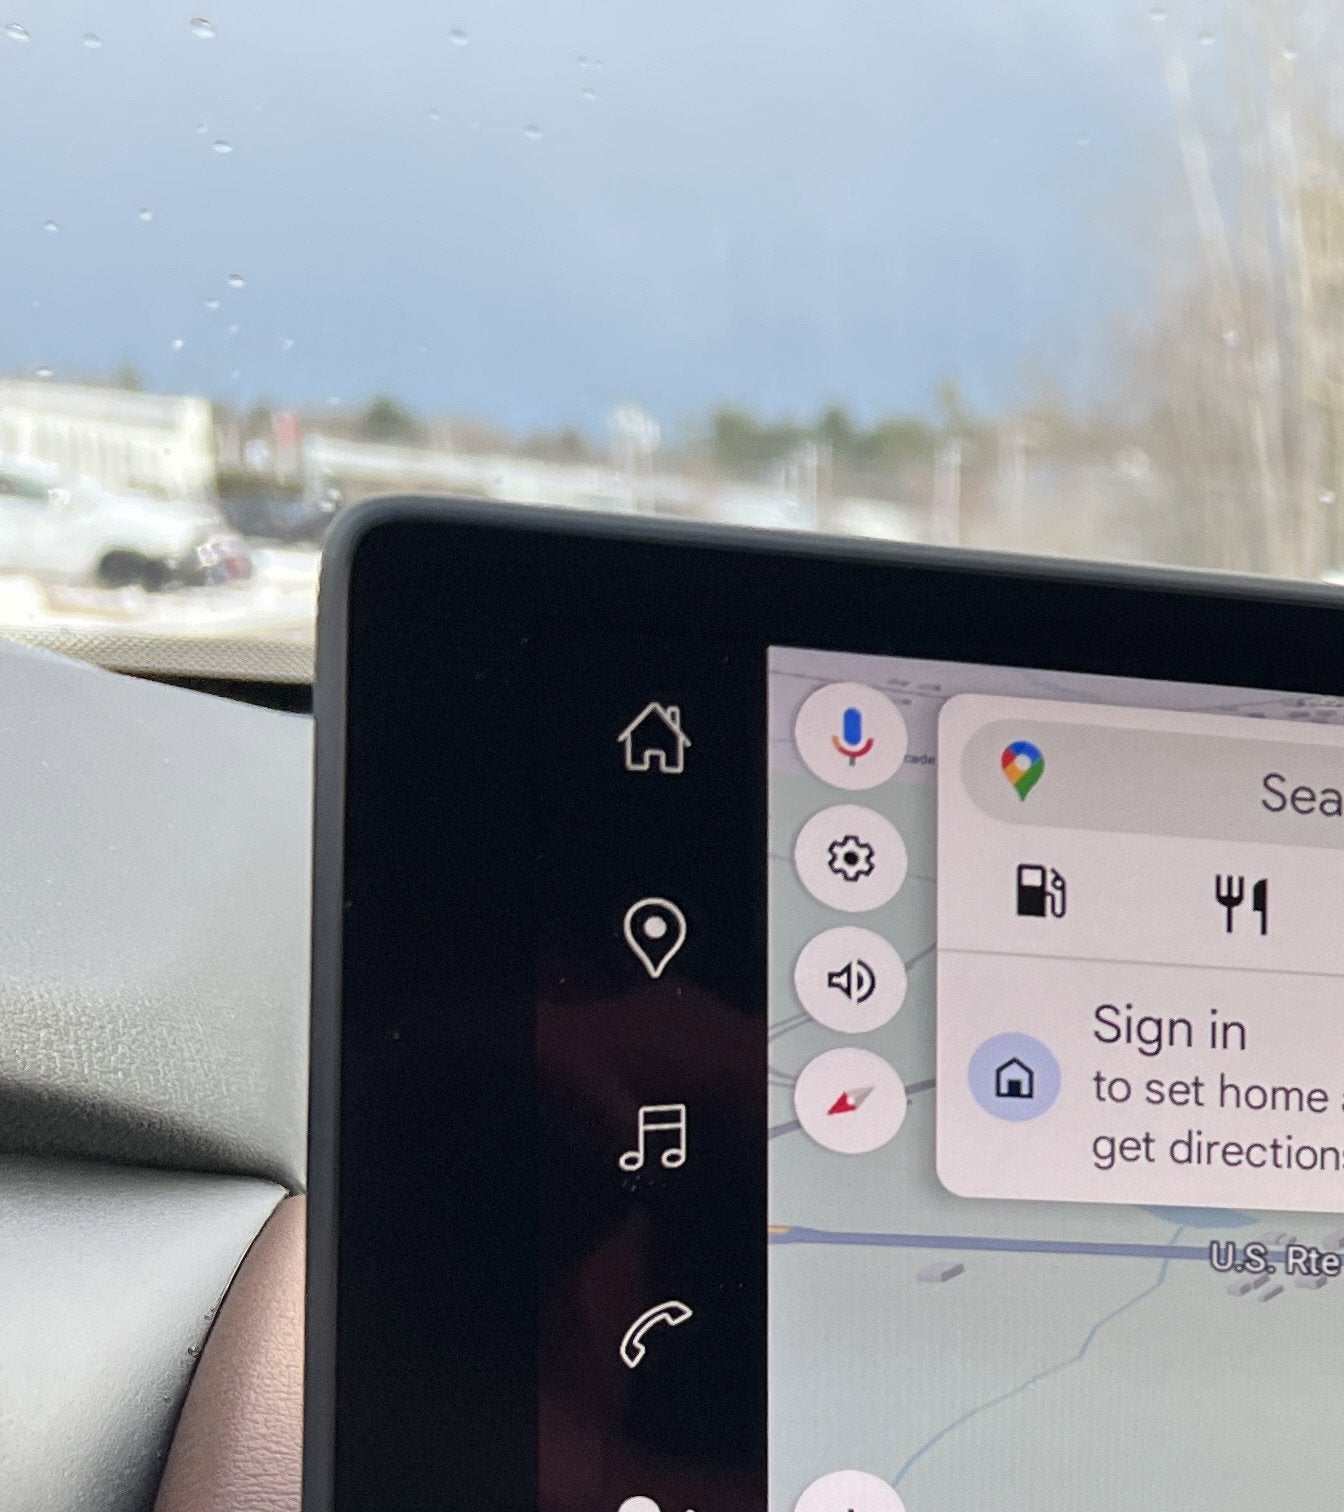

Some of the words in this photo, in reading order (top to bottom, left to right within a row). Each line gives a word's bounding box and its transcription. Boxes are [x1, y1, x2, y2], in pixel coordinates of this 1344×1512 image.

[1093, 1003, 1193, 1057] Sign
[1208, 1008, 1247, 1051] in
[1093, 1070, 1132, 1104] to
[1145, 1074, 1205, 1108] set
[1218, 1072, 1330, 1114] home
[1092, 1131, 1156, 1171] get
[1209, 1239, 1277, 1275] U.S.
[1285, 1243, 1343, 1277] Rte
